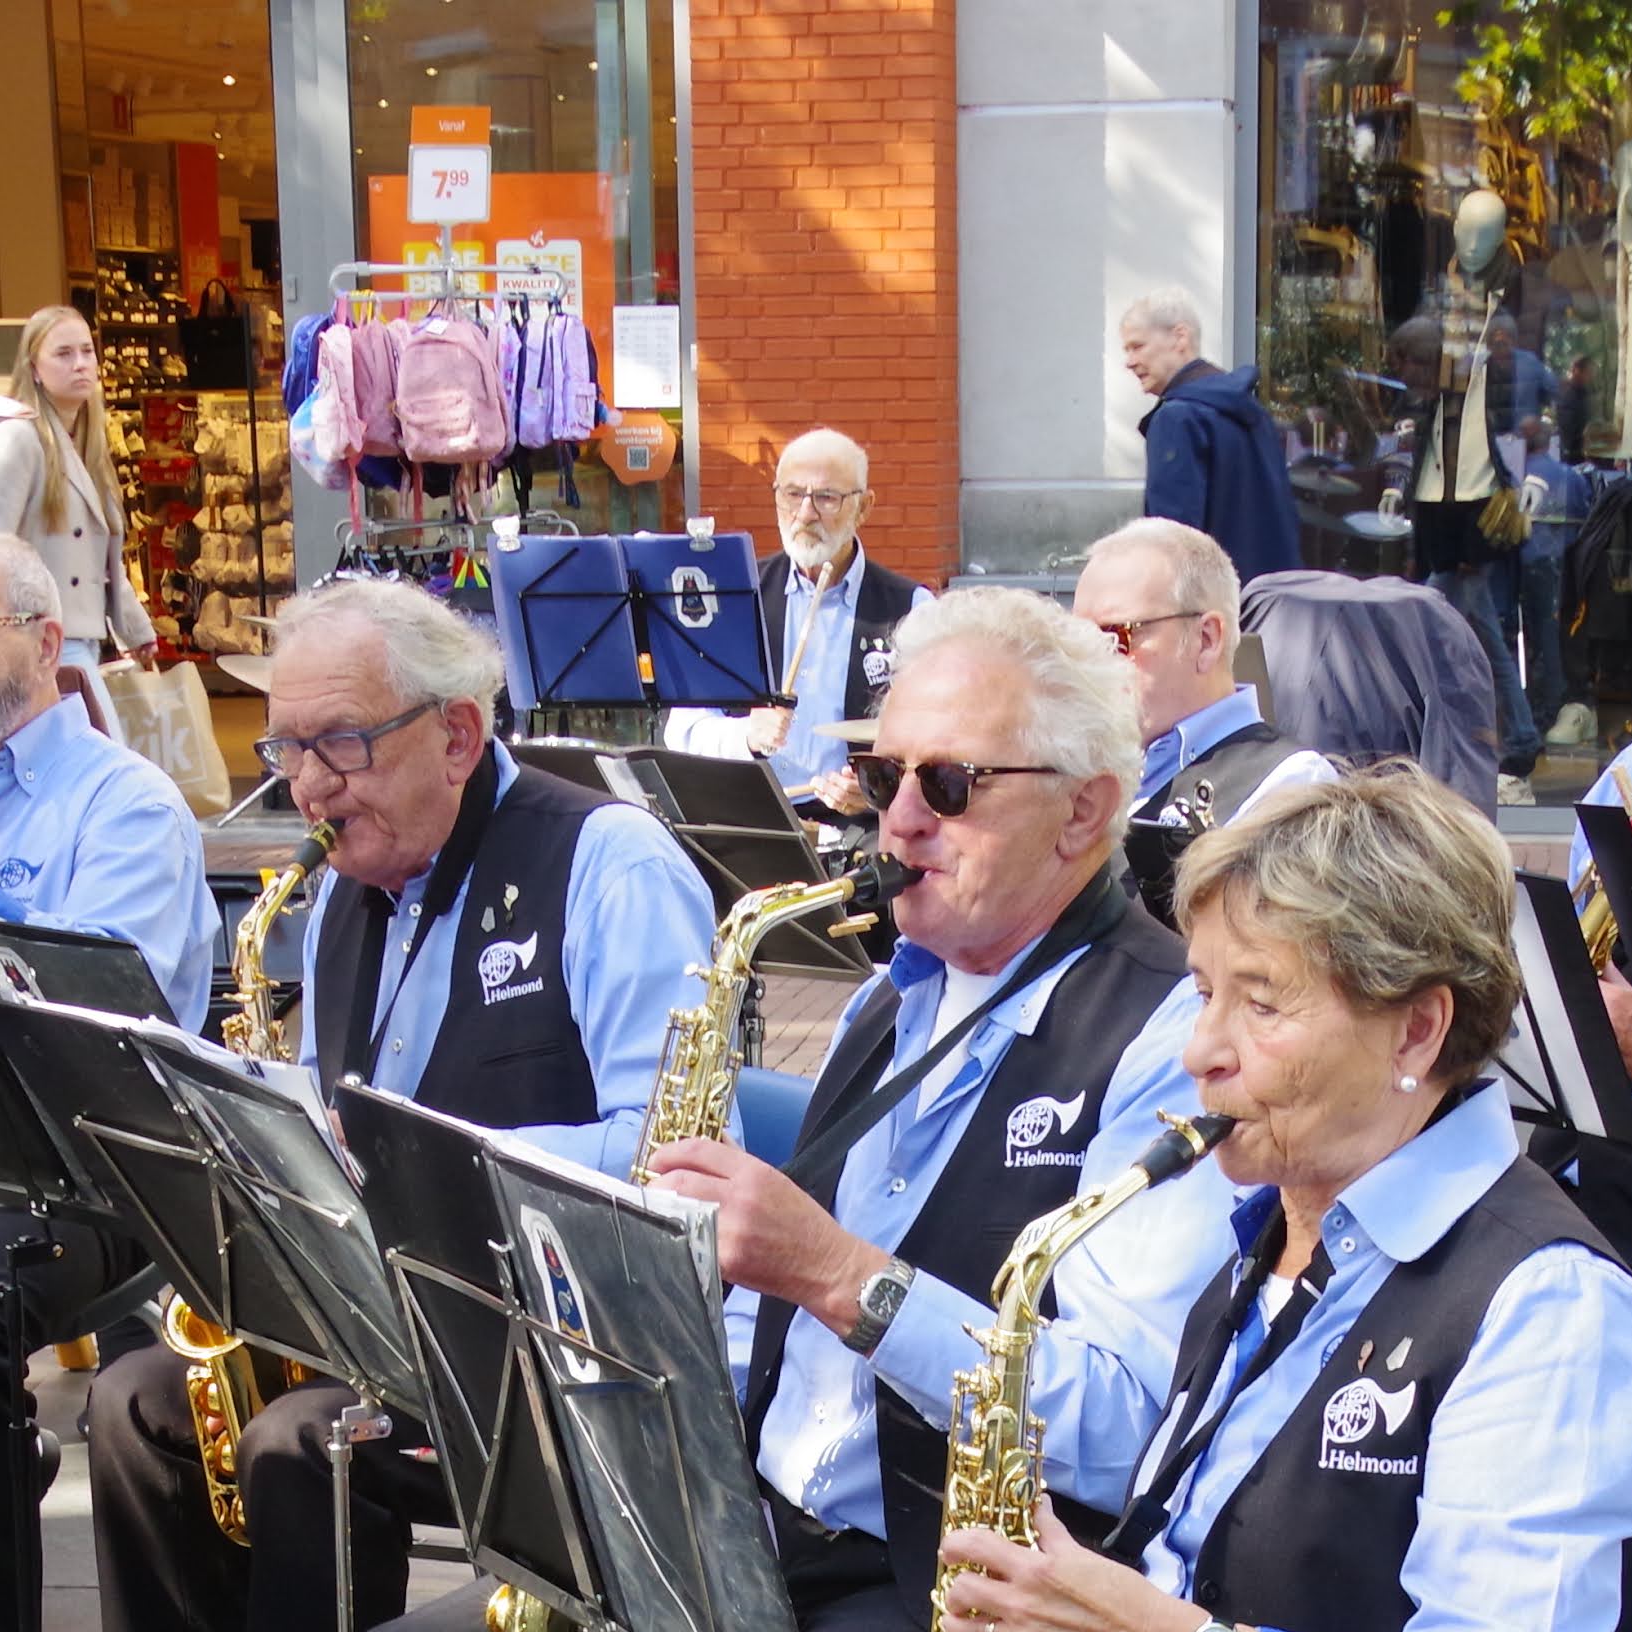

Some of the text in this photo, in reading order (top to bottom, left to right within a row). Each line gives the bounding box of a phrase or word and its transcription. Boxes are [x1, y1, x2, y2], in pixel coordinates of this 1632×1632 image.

[431, 169, 469, 199] 7.99
[491, 976, 544, 1003] Helmond
[1014, 1149, 1086, 1168] Helmond
[1328, 1449, 1419, 1475] Helmond
